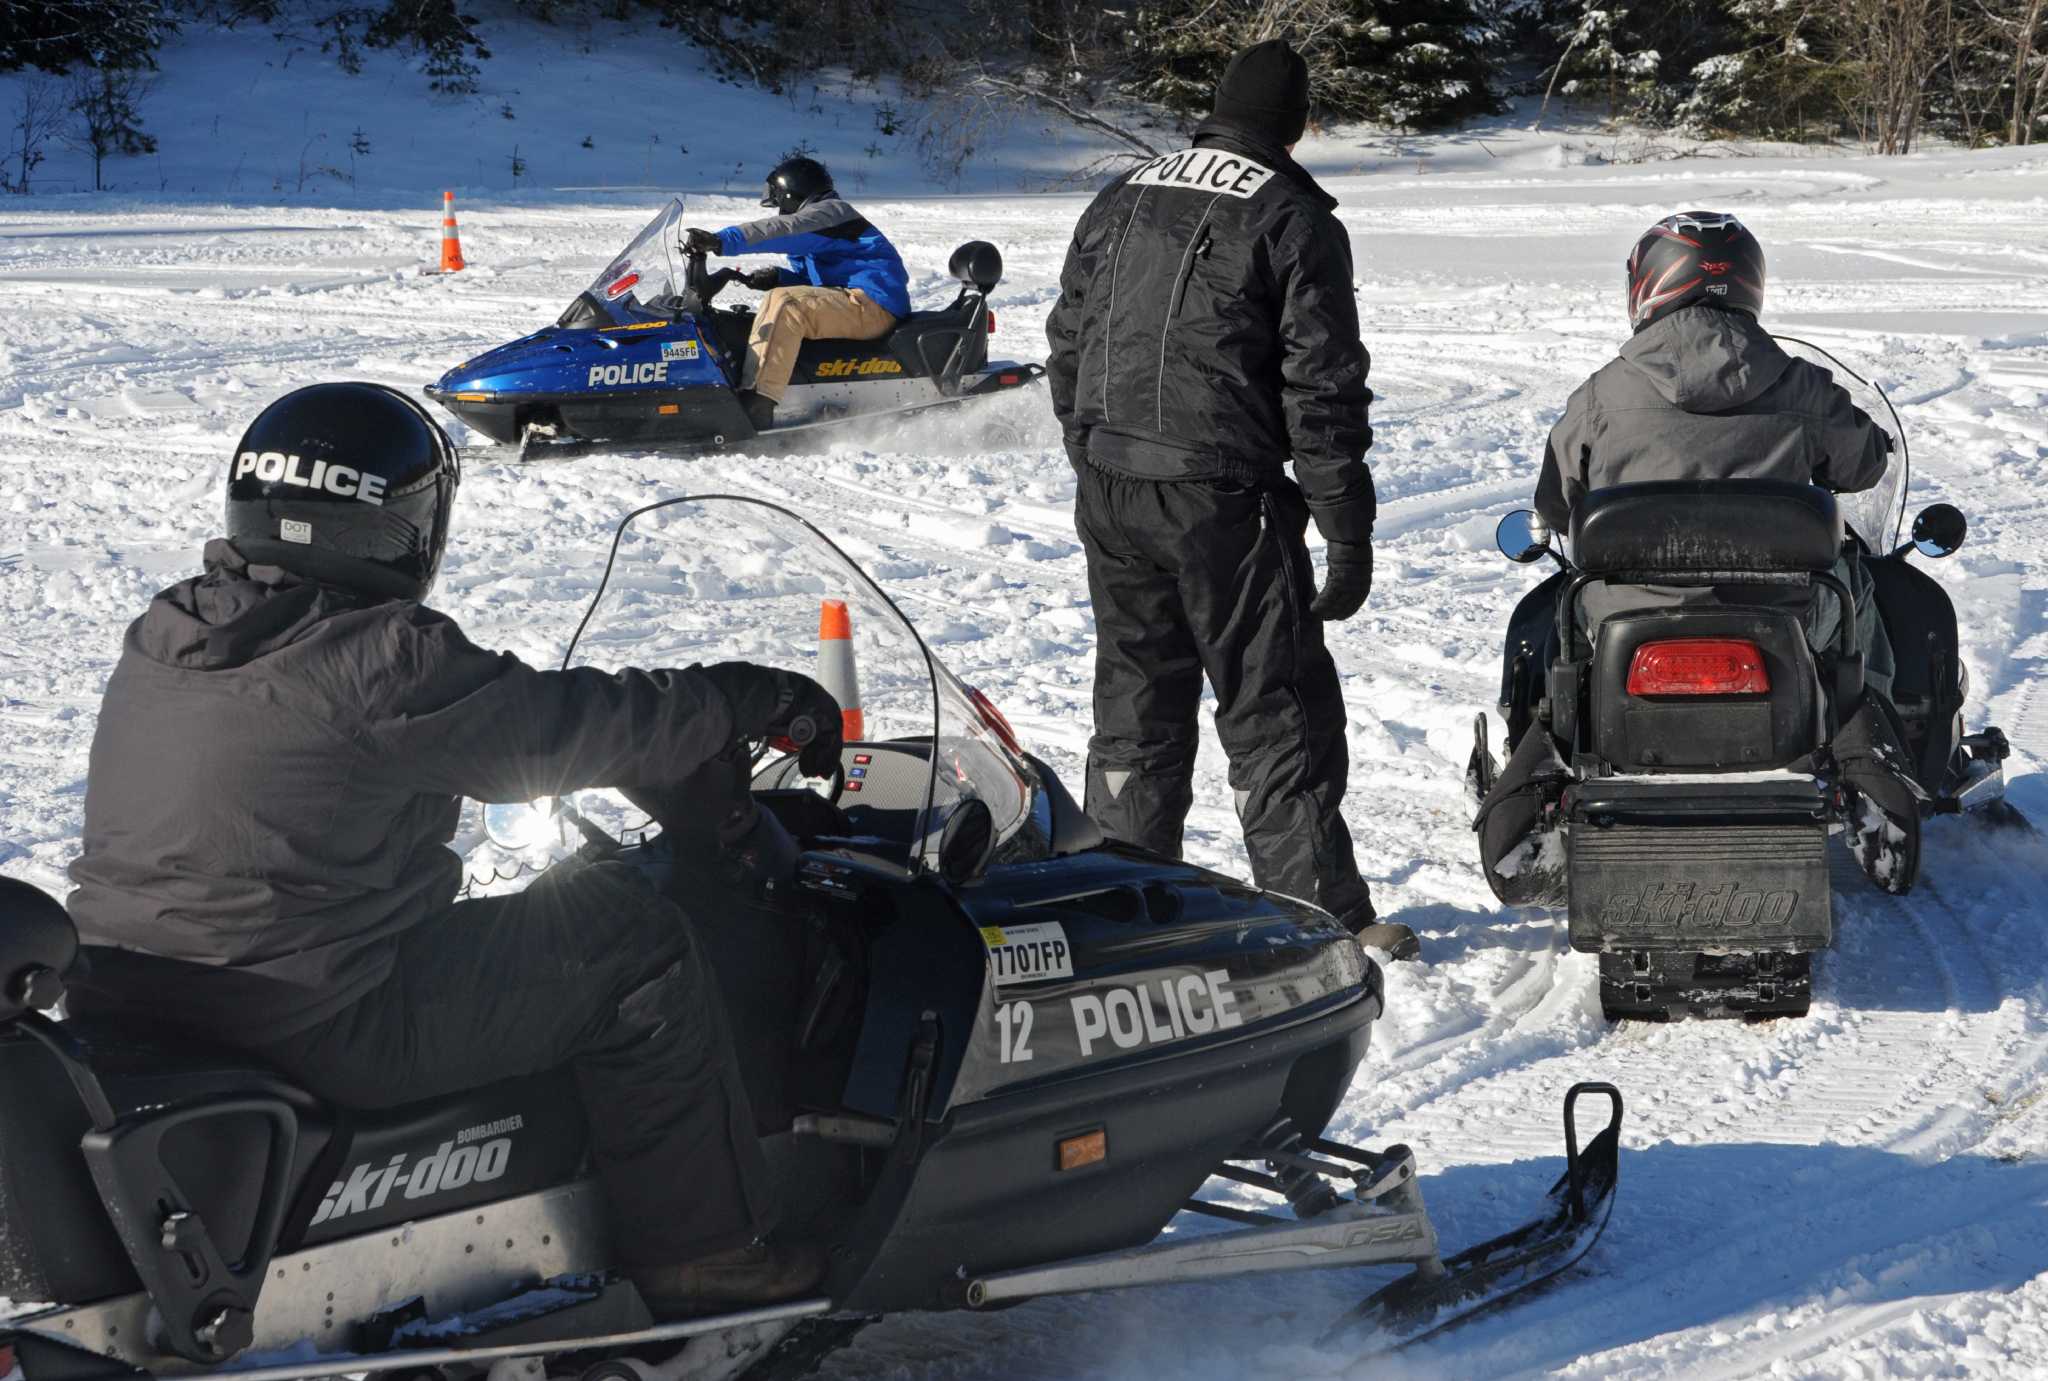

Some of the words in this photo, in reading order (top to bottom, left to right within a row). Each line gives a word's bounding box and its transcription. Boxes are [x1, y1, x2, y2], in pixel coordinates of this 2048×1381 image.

[1136, 152, 1265, 194] POLICE
[588, 361, 669, 387] POLICE
[235, 451, 388, 507] POLICE
[284, 521, 309, 533] DOT
[990, 940, 1066, 976] 7707FP
[994, 1000, 1034, 1064] 12
[1070, 968, 1244, 1057] POLICE
[457, 1114, 524, 1145] BOMBARDIER
